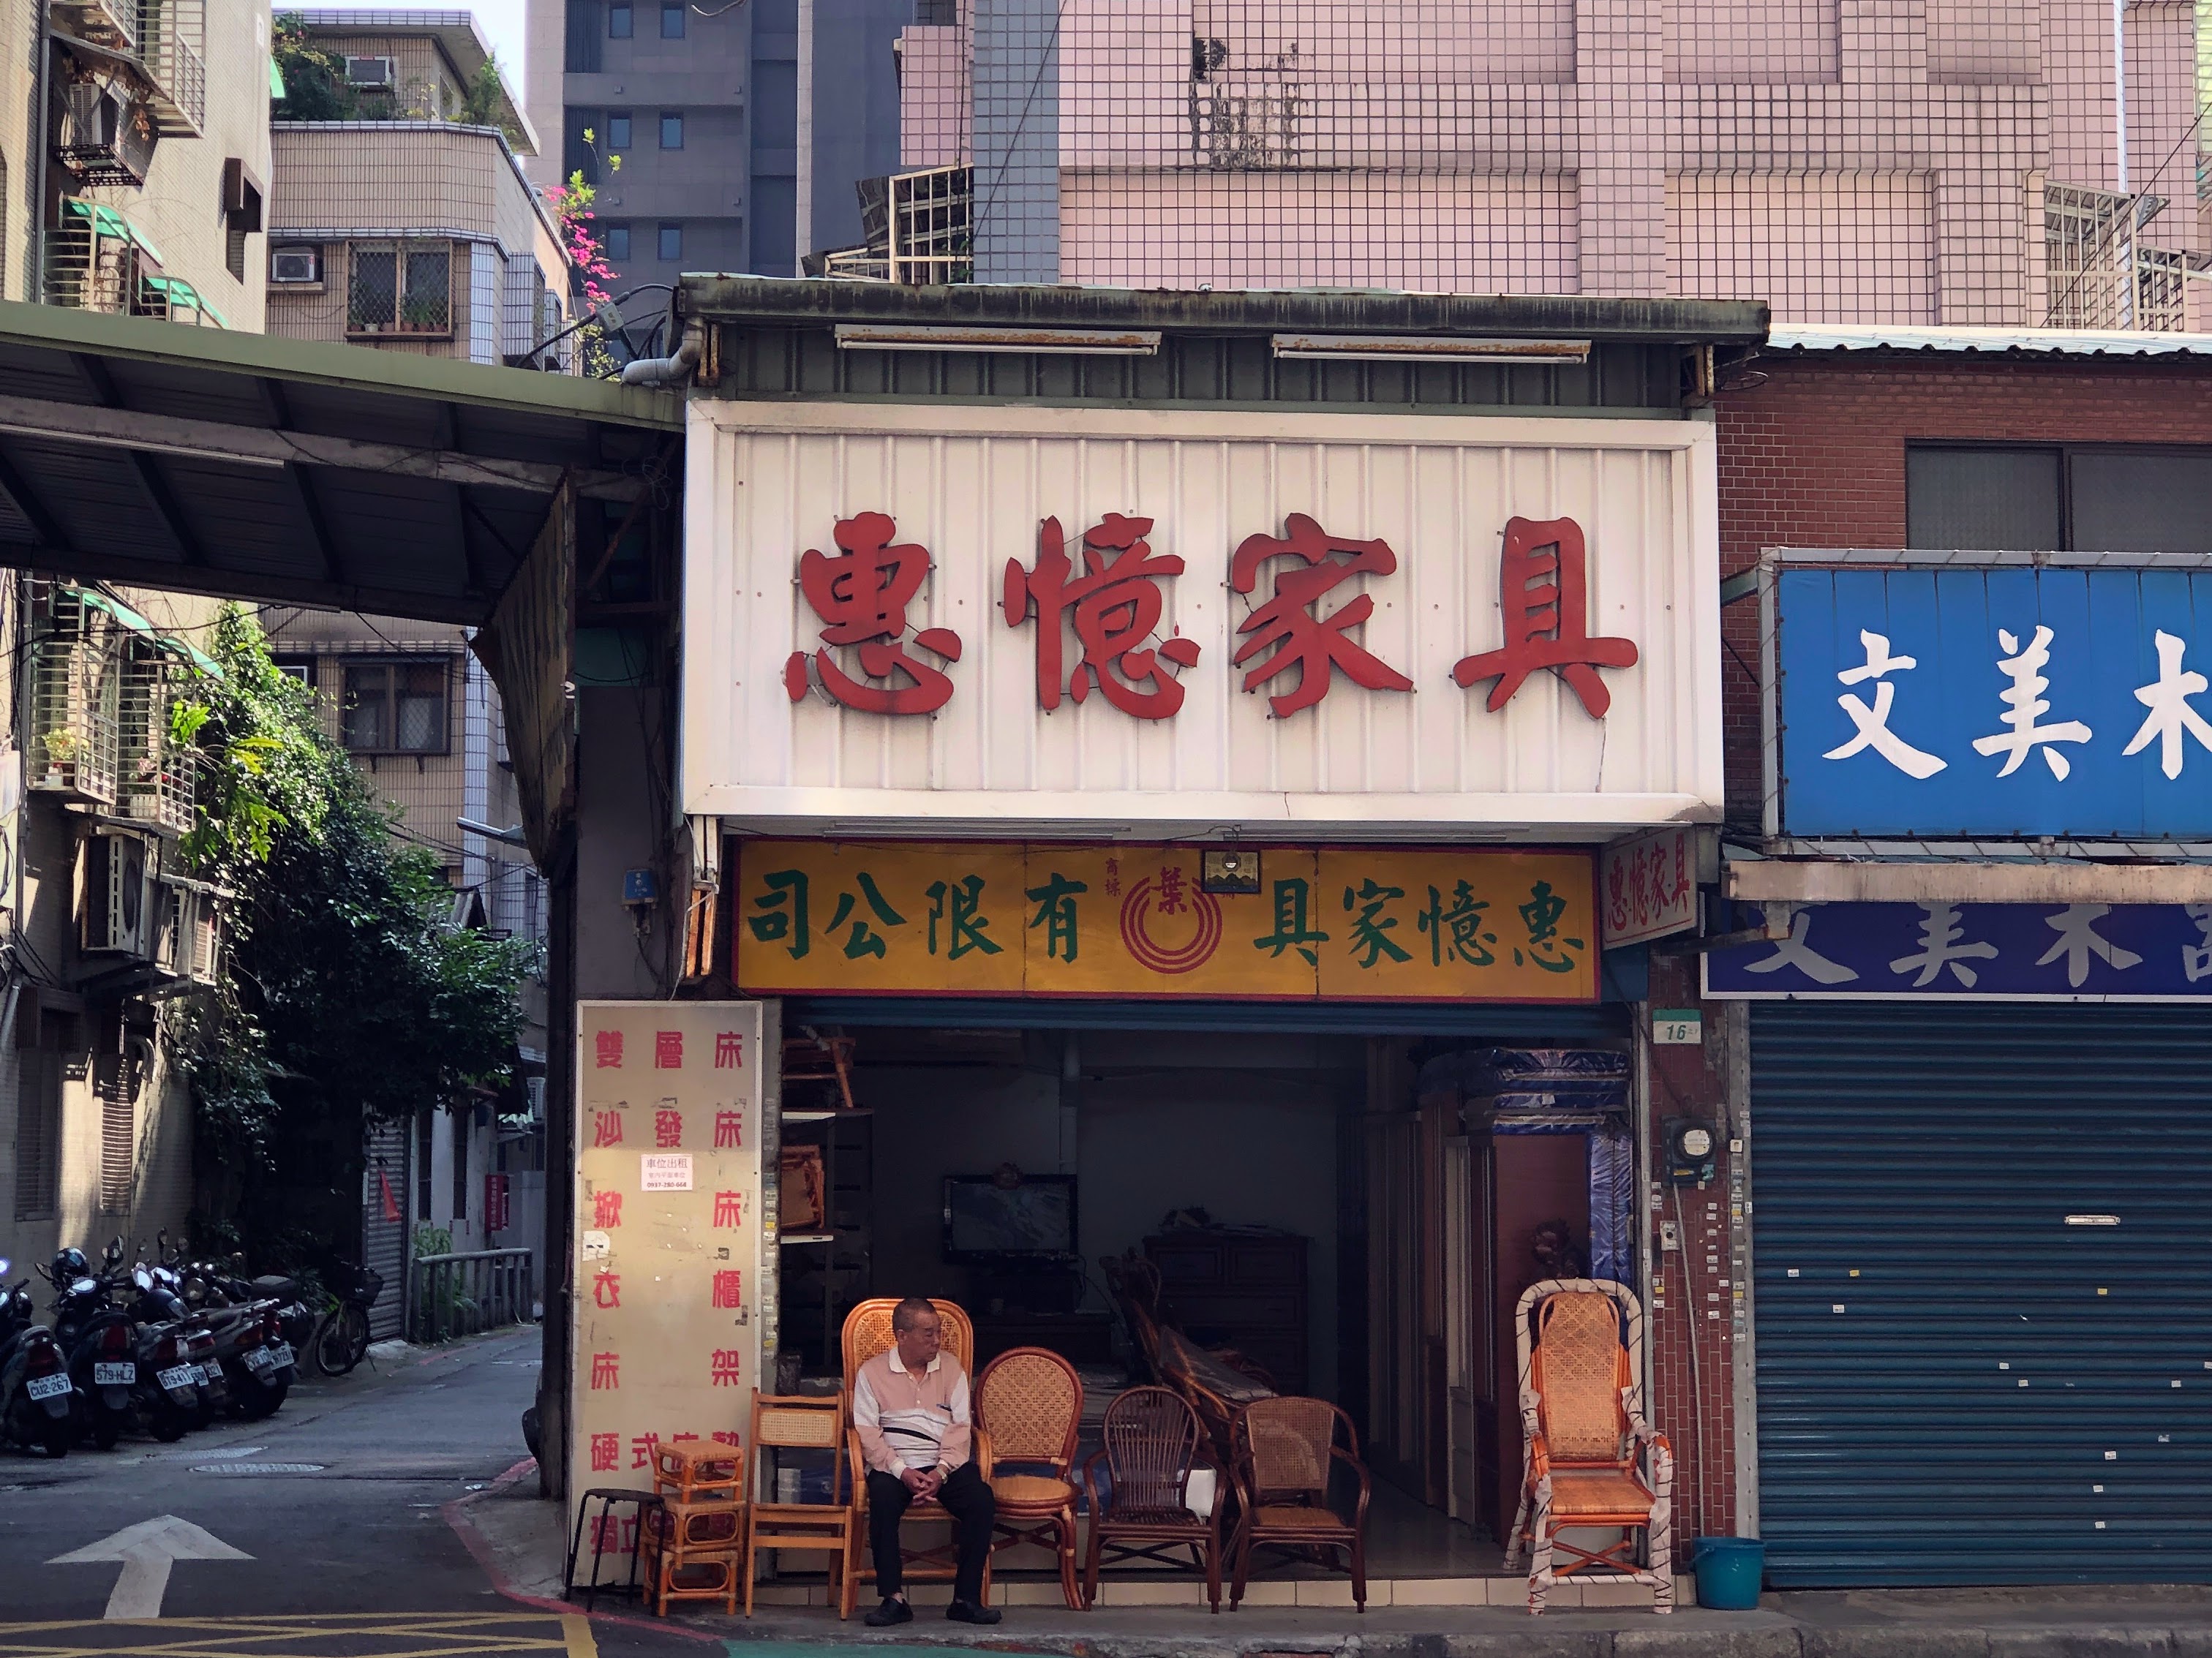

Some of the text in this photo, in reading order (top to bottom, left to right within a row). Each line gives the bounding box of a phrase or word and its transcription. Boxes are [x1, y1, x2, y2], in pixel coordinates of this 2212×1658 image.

[784, 510, 1639, 720] 惠憶家具
[1822, 625, 2212, 782] 文美木
[595, 1030, 743, 1069] 雙層床
[593, 1109, 742, 1148] 沙發床
[647, 1158, 688, 1169] 車位出租
